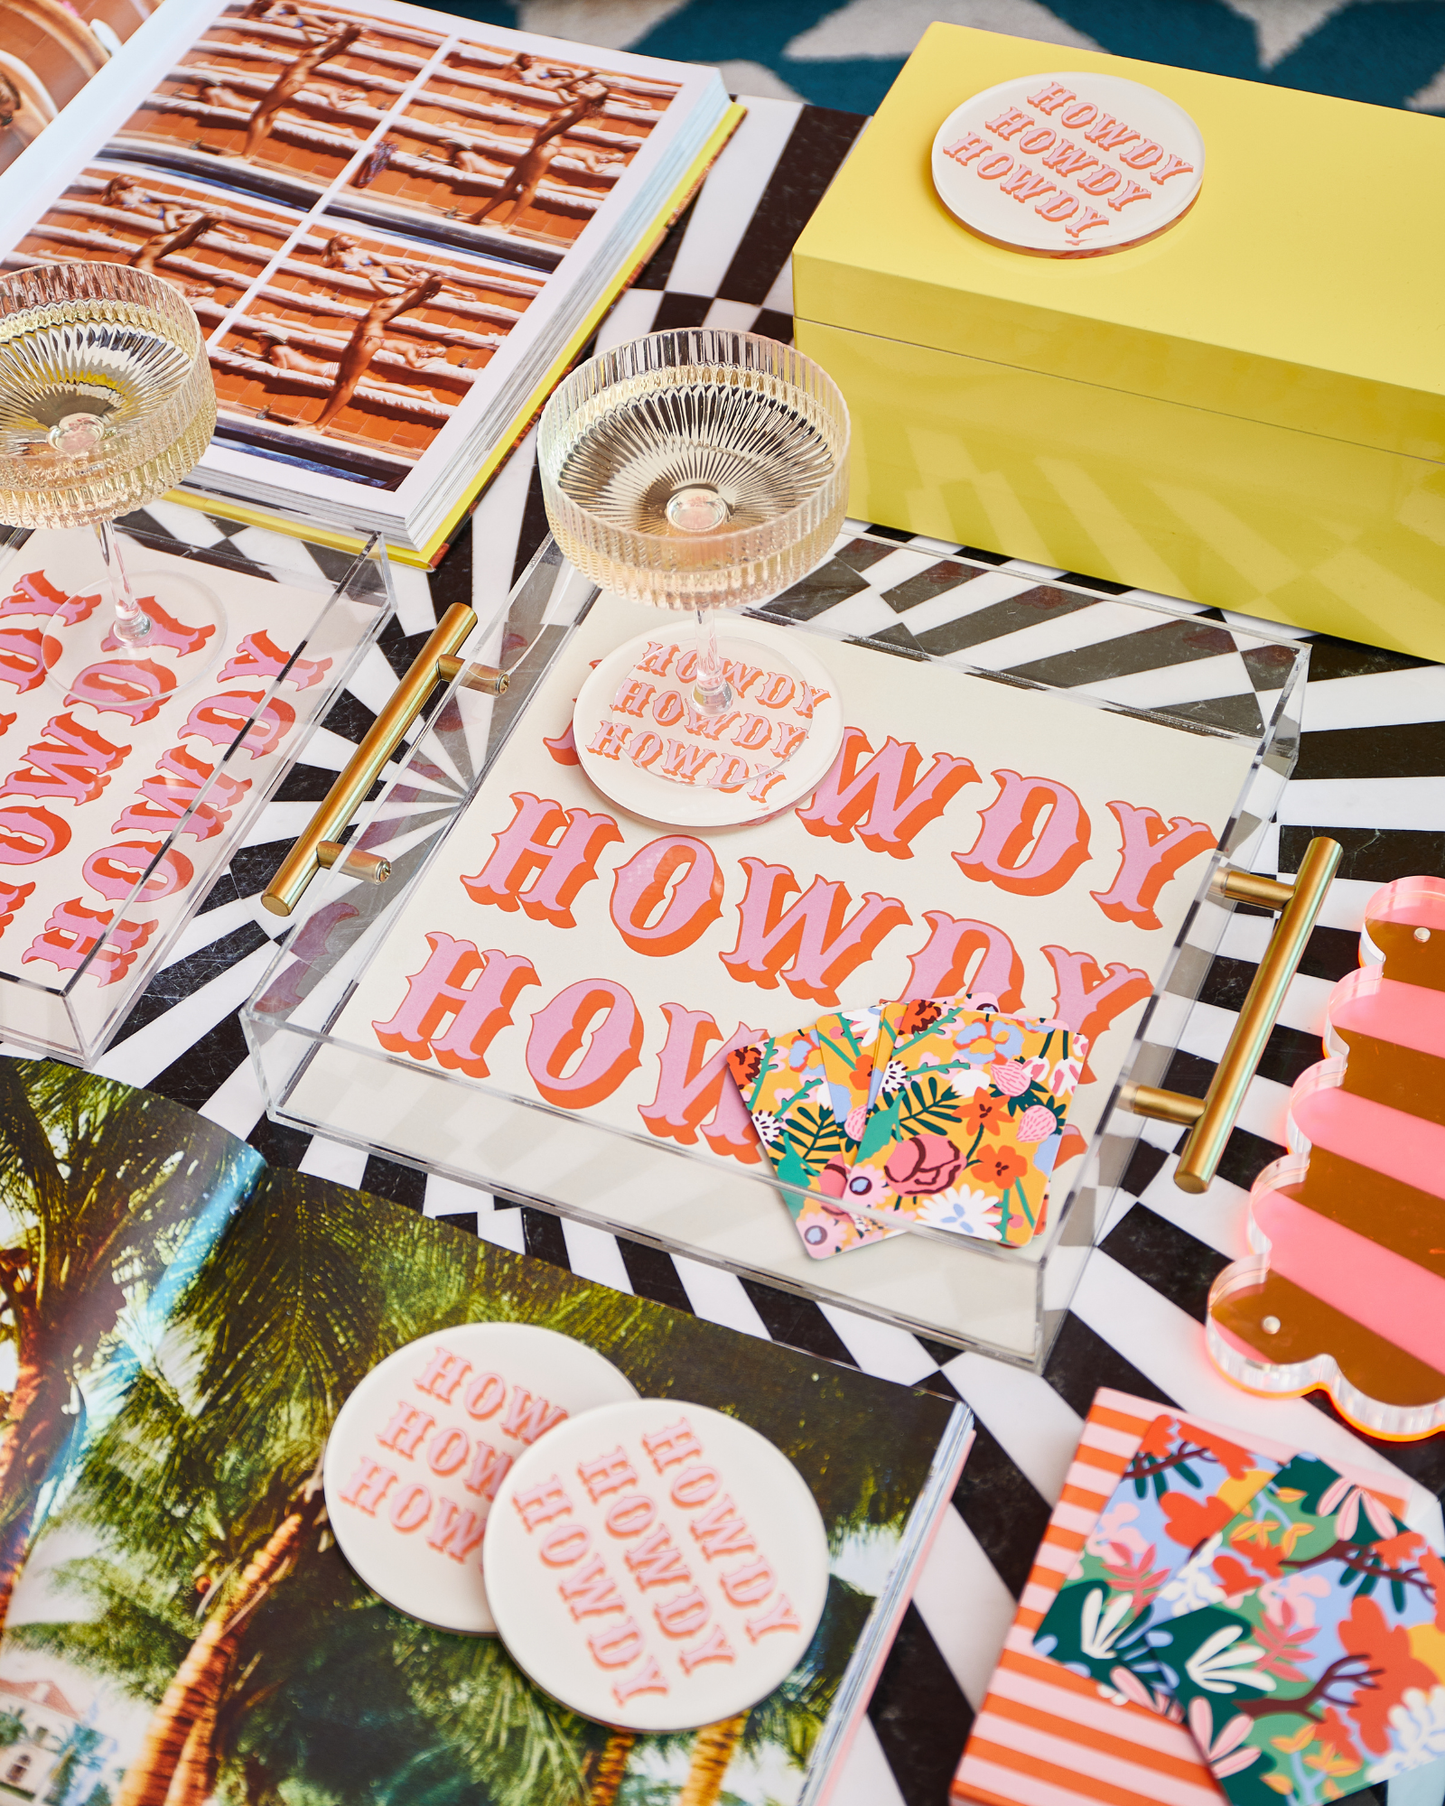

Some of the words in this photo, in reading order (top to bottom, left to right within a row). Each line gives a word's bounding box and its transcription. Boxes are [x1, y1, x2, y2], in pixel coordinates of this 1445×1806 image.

[943, 131, 1109, 238] HOWDY
[985, 106, 1152, 212] HOWDY
[1027, 81, 1194, 185] HOWDY
[0, 595, 216, 938] OWDY
[21, 628, 333, 988] HOWDY
[585, 719, 787, 803] HOWDY
[376, 1401, 514, 1503] HOW
[414, 1346, 569, 1446] HOW
[338, 1455, 486, 1574] HOW
[577, 1445, 737, 1677] HOWDY
[641, 1416, 802, 1645] HOWDY
[512, 1474, 669, 1708] HOWDY
